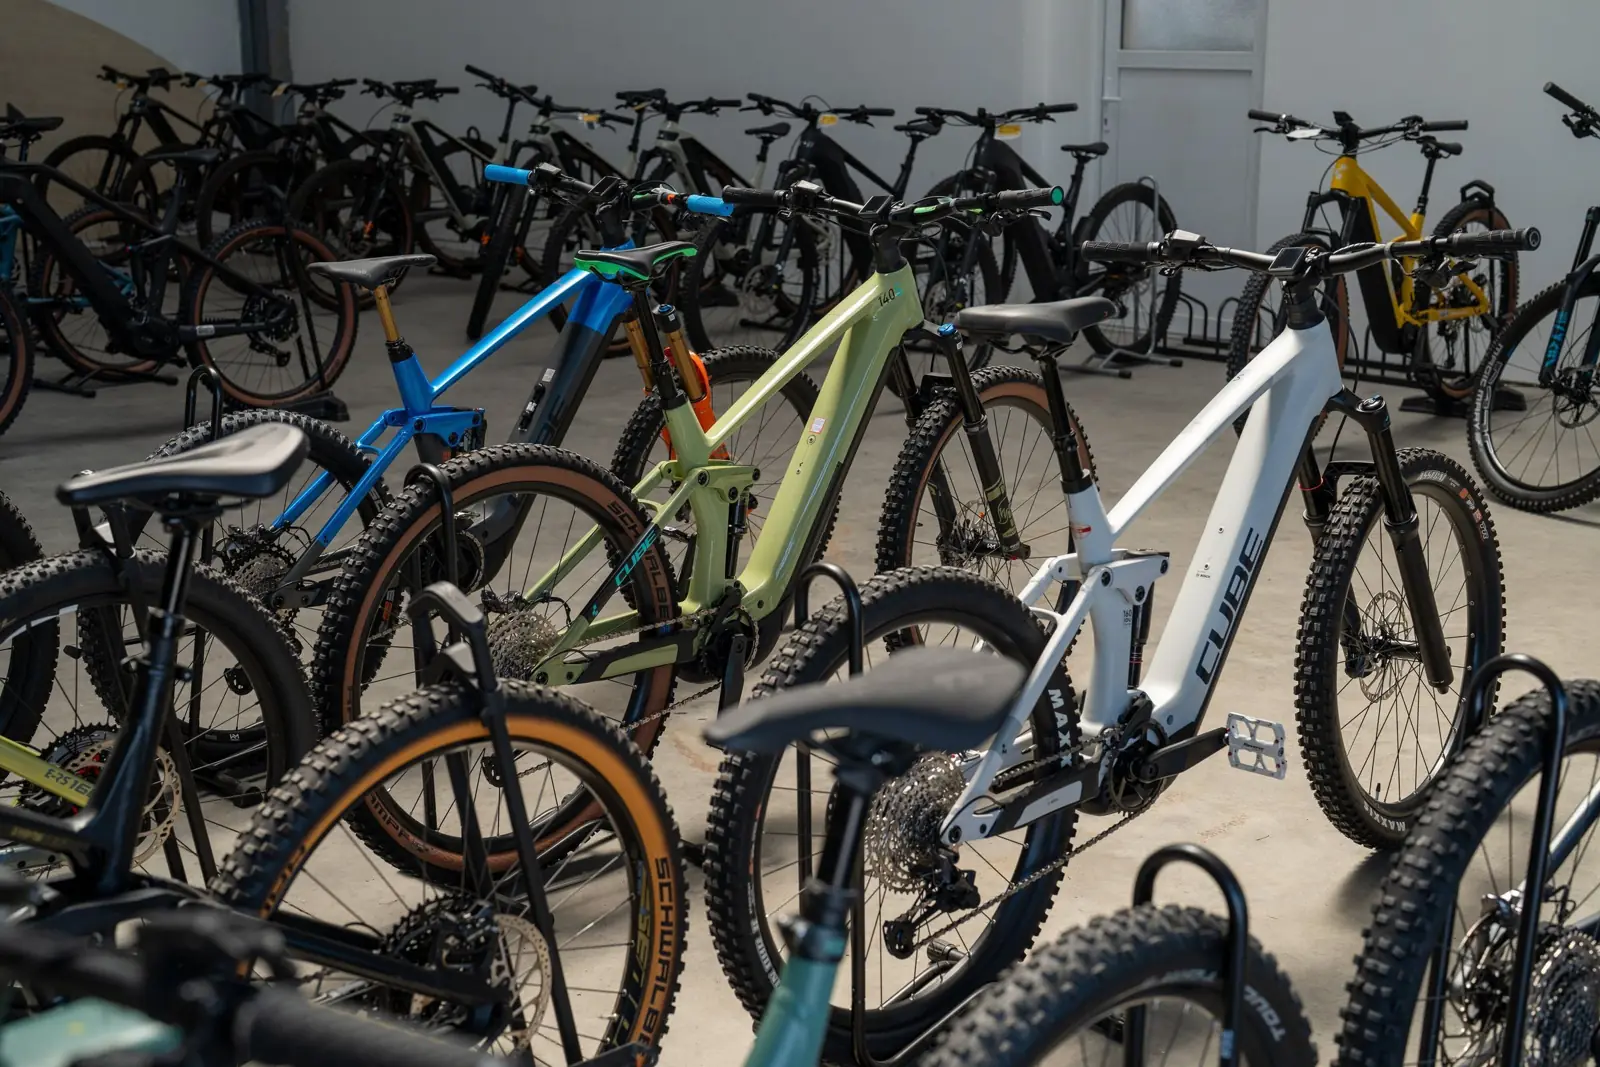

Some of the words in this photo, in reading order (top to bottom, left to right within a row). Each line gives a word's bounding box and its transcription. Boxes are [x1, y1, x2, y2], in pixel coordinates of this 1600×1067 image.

[877, 288, 896, 307] 140
[607, 500, 671, 619] SCHALBE
[614, 529, 657, 587] CUBE
[1195, 526, 1263, 685] CUBE
[1048, 689, 1073, 768] MAXX
[1363, 800, 1406, 832] MAXXIS
